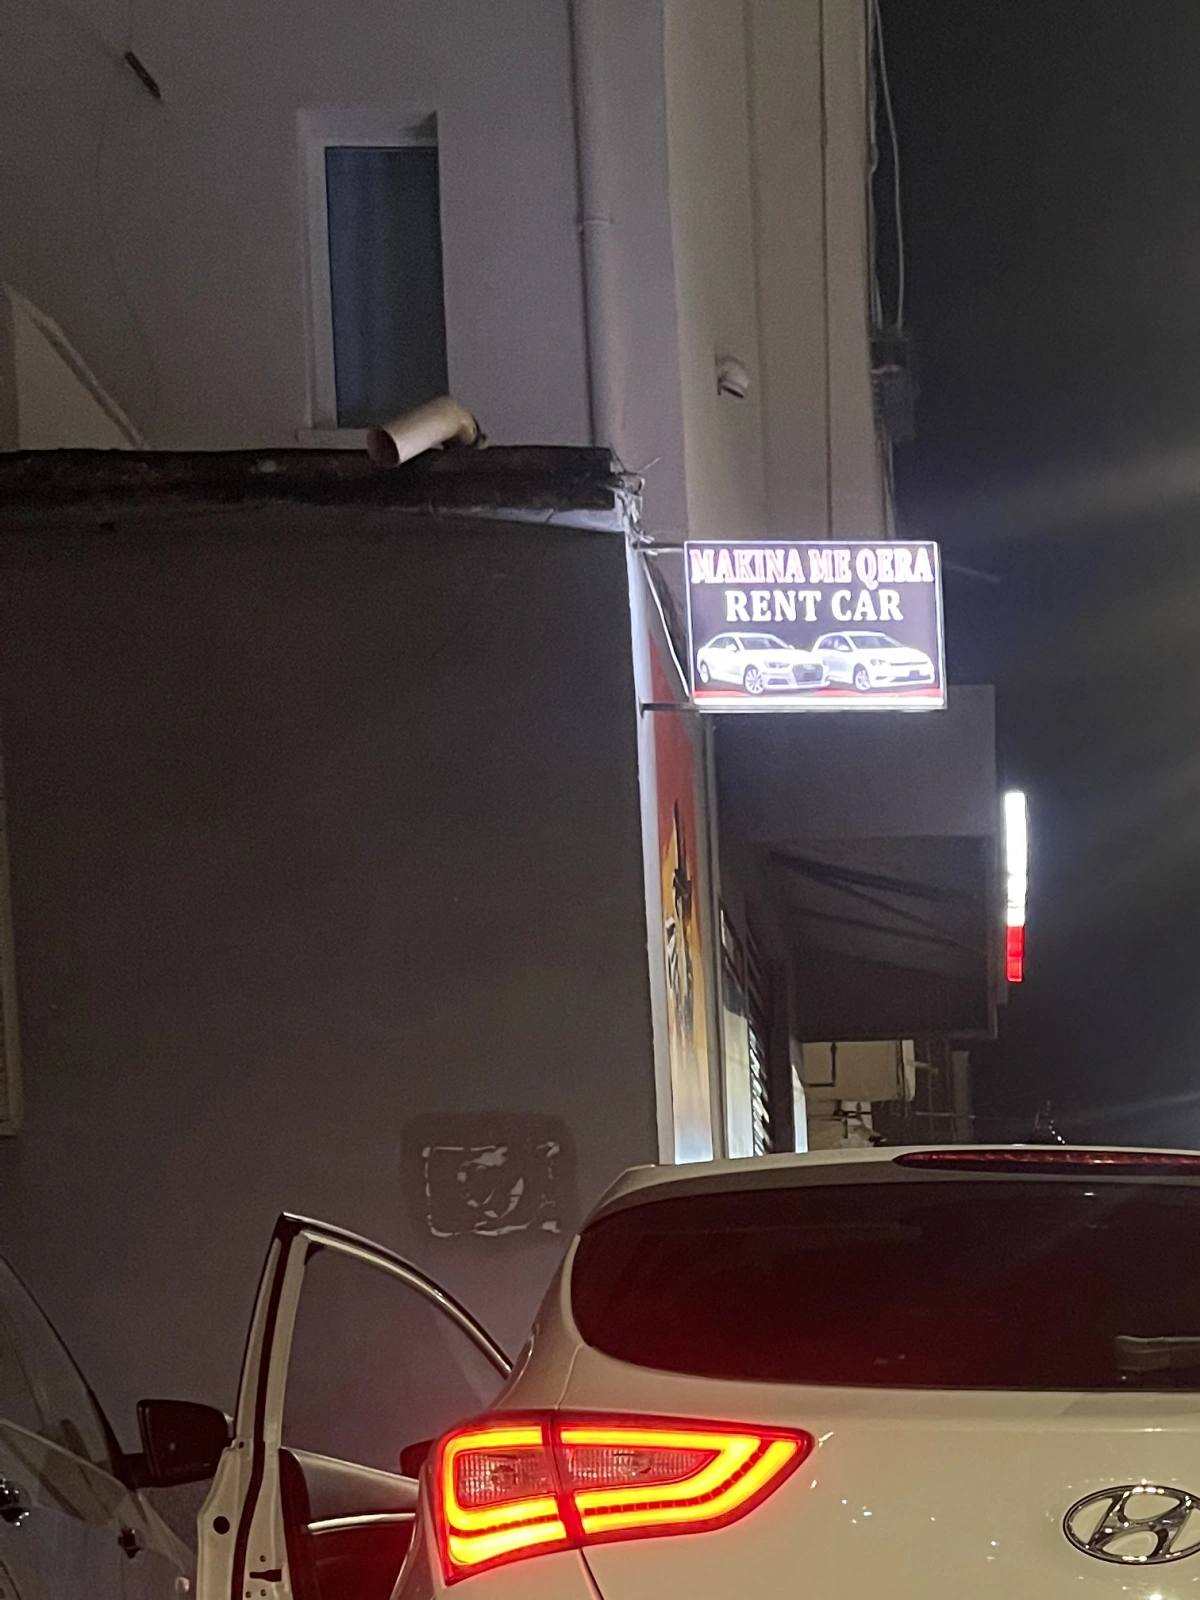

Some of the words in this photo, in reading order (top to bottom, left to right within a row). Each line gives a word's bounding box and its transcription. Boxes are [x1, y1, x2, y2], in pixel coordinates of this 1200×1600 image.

[689, 549, 805, 583] MAKINA
[808, 549, 852, 583] ME
[855, 548, 933, 590] QERA
[725, 589, 821, 622] RENT
[831, 589, 903, 621] CAR
